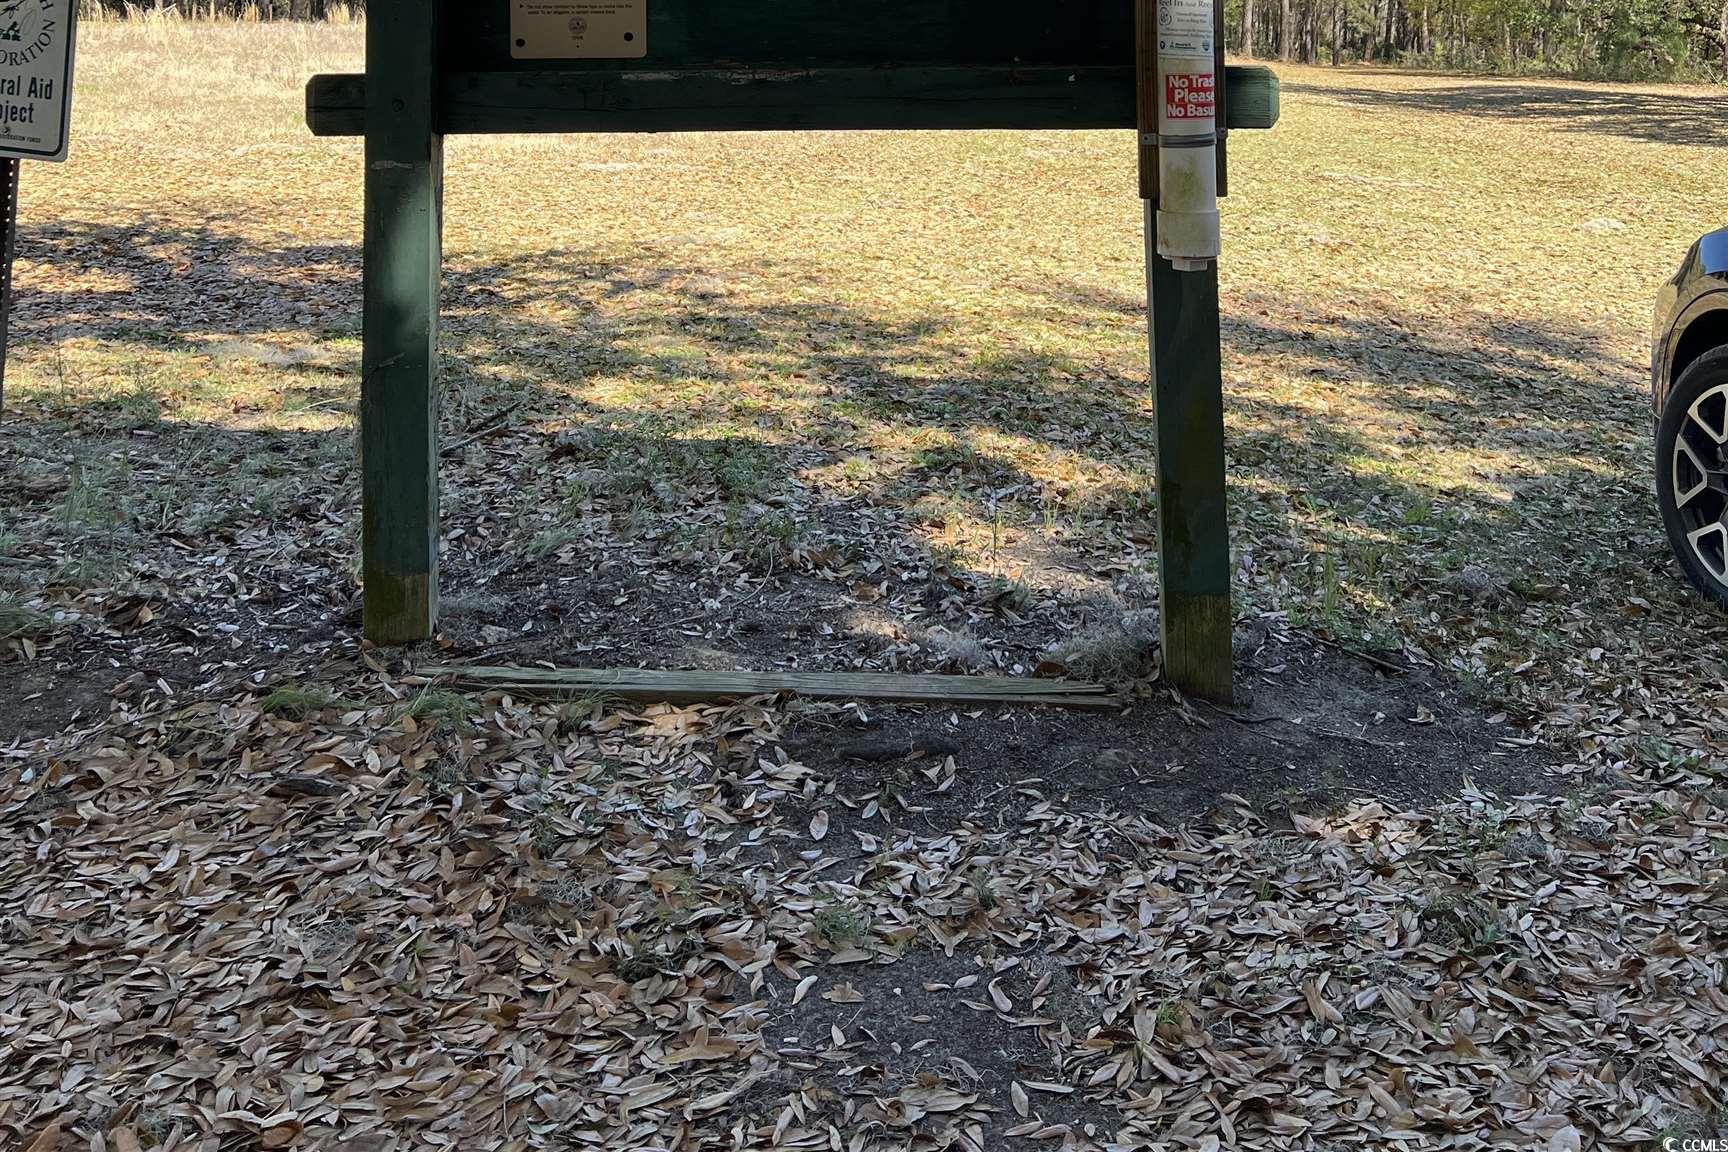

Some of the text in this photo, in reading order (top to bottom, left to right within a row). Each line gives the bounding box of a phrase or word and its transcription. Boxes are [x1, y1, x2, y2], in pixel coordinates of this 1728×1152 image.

[27, 77, 53, 100] Aid
[1168, 75, 1189, 88] No
[1167, 103, 1185, 117] No
